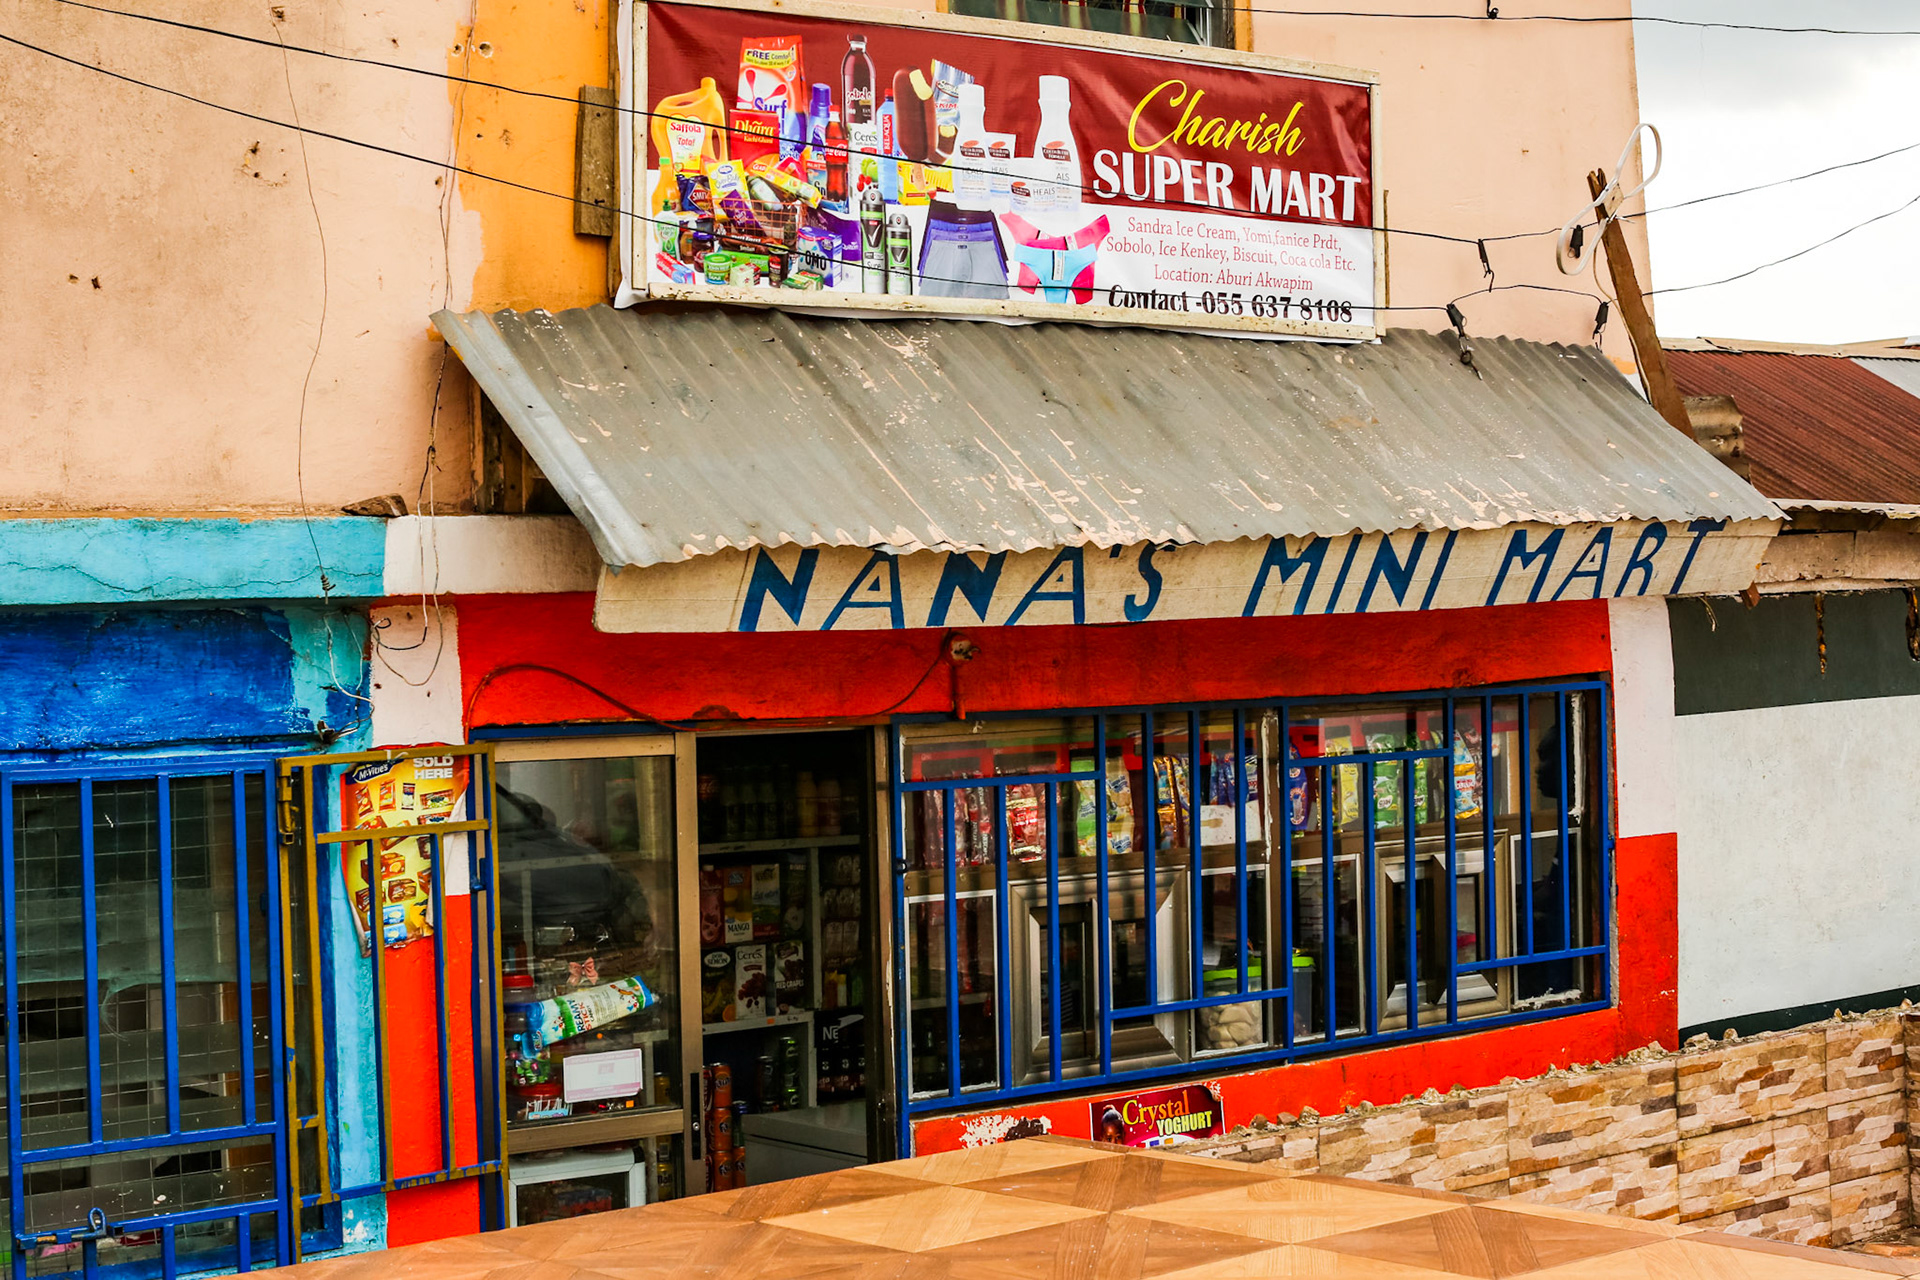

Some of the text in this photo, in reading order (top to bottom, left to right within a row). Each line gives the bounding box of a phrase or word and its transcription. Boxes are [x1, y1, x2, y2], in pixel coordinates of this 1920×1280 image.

[670, 121, 701, 134] Saffola
[1128, 79, 1305, 157] Charish
[854, 131, 877, 142] Ceres
[1032, 187, 1055, 196] HEALS
[1093, 149, 1361, 221] SUPER MART
[1128, 217, 1172, 236] Sandra
[1176, 221, 1193, 237] Ice
[1197, 223, 1240, 243] Cream,
[1313, 233, 1342, 251] Prdt,
[805, 249, 827, 271] OMO
[1106, 237, 1356, 271] Sobolo, Ice Kenkey, Biscuit, Coca cola Etc.
[1154, 264, 1313, 294] Location: Aburi Akwapim
[1108, 284, 1190, 312] Contact
[1251, 294, 1292, 319] 637
[1299, 297, 1353, 323] 8108
[738, 519, 1726, 633] NANA'S MINI MART
[413, 755, 454, 768] SOLD
[414, 767, 454, 780] HERE
[727, 922, 750, 933] MANGO
[737, 950, 763, 960] Ceres
[579, 1001, 592, 1031] STICK
[1122, 1089, 1190, 1130] Crystal
[1156, 1110, 1213, 1137] YOGHURT
